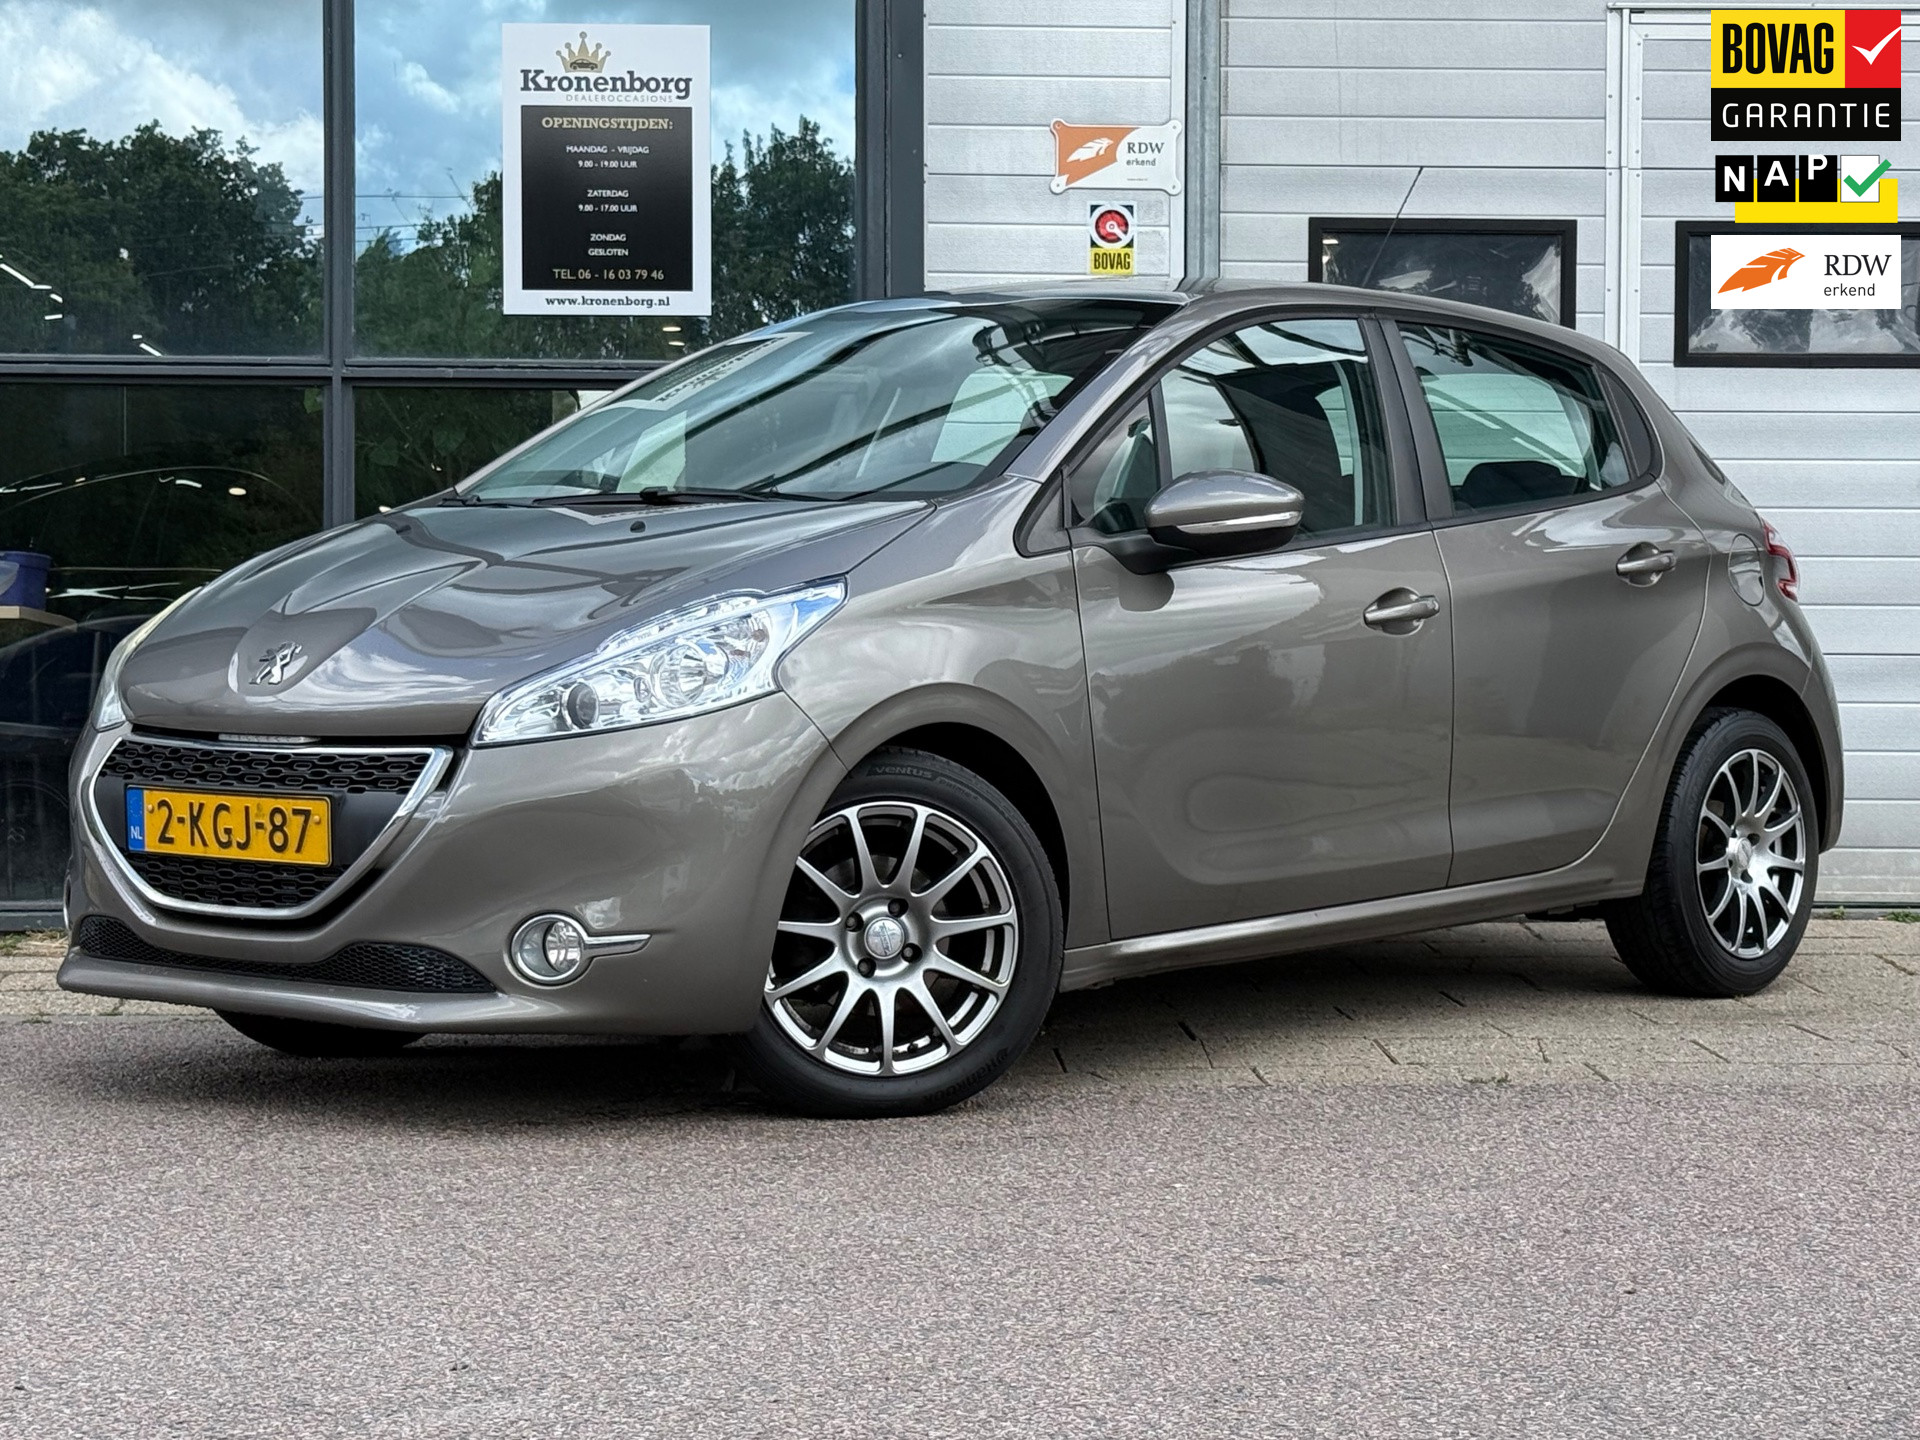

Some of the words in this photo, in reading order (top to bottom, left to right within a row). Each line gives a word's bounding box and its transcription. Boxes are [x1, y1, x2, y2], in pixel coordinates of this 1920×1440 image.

[520, 69, 692, 100] Kronenborg
[566, 94, 673, 103] DEALEROCCASIONS
[541, 117, 674, 131] OPENINGSTIJDEN:
[566, 145, 608, 153] MAANDAG
[617, 146, 650, 155] VRIJDAG
[1127, 142, 1165, 154] RDW
[578, 160, 594, 168] 9.00
[600, 160, 619, 168] 19.00
[1126, 158, 1156, 166] erkend
[578, 204, 594, 212] 9.00
[600, 204, 619, 212] 17.00
[588, 248, 629, 256] GESLOTEN
[1093, 252, 1131, 270] BOVAG
[604, 269, 615, 279] 16
[618, 269, 631, 280] 03
[634, 269, 648, 280] 79
[650, 270, 664, 280] 46
[545, 296, 671, 308] www.kronenborg.nl
[157, 798, 312, 854] 2-KGJ-87
[130, 825, 143, 840] NL
